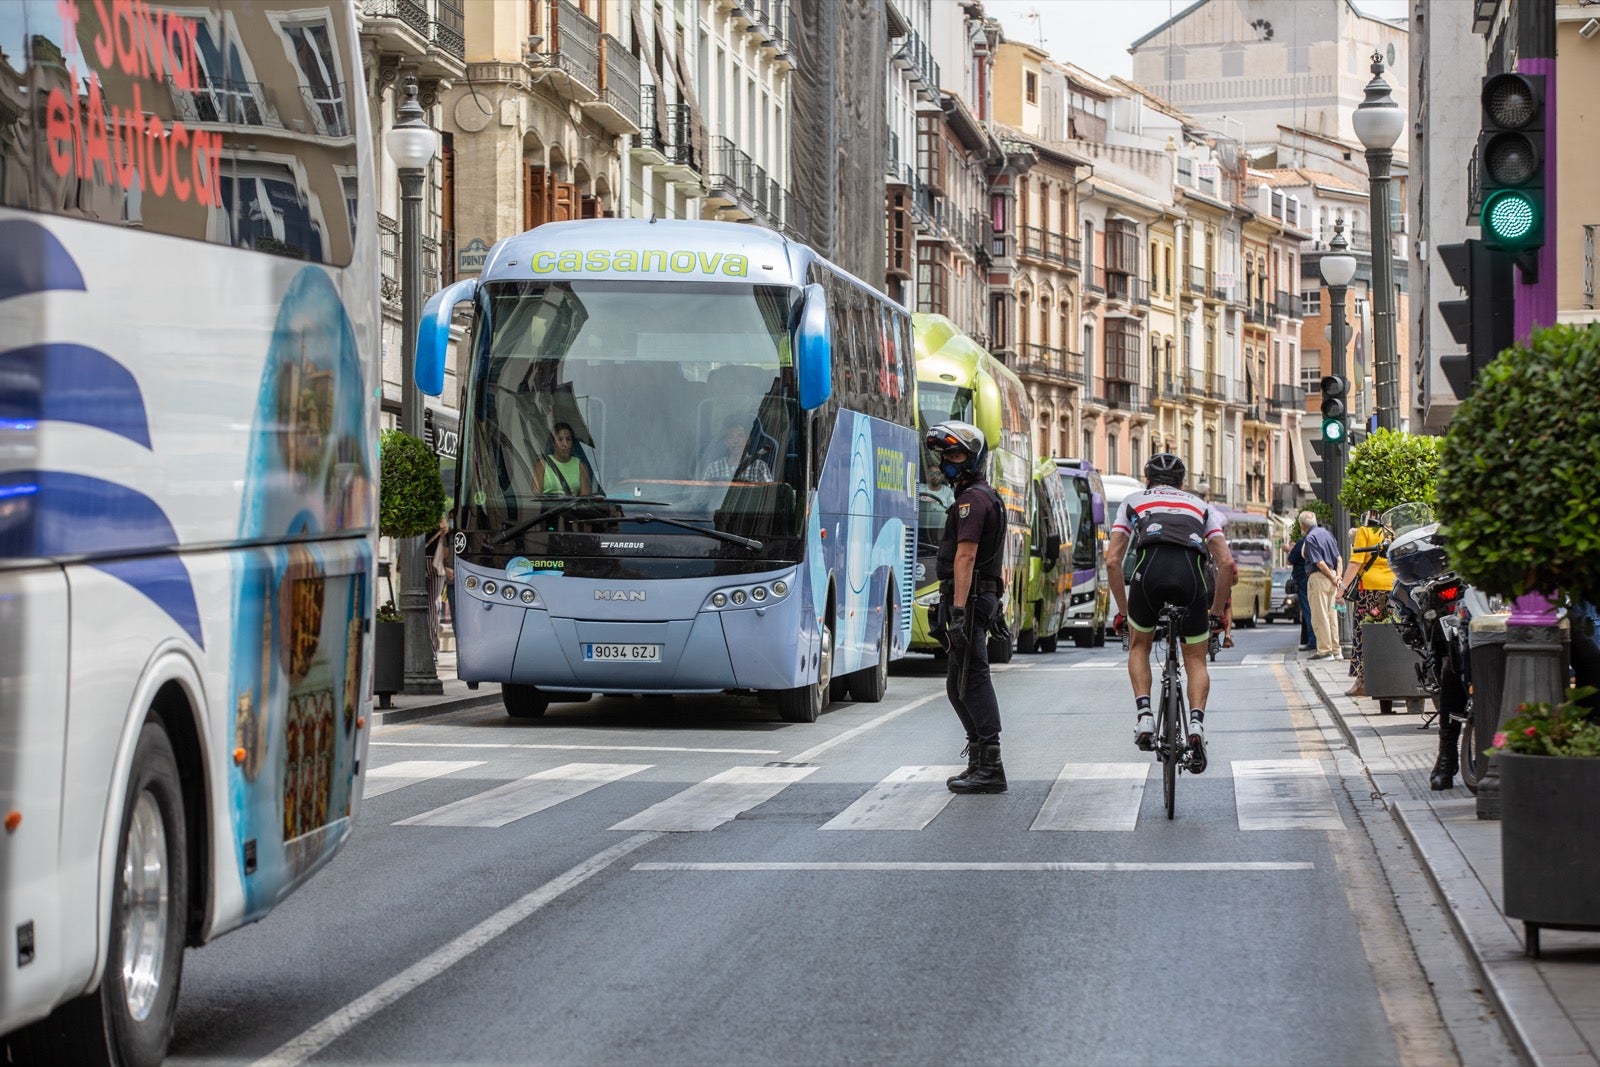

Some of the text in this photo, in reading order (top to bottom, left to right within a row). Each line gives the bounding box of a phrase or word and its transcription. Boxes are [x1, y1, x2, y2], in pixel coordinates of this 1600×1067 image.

[531, 249, 749, 278] casanova
[594, 590, 646, 601] MAN
[595, 646, 627, 658] 9034
[632, 646, 656, 658] GZJ
